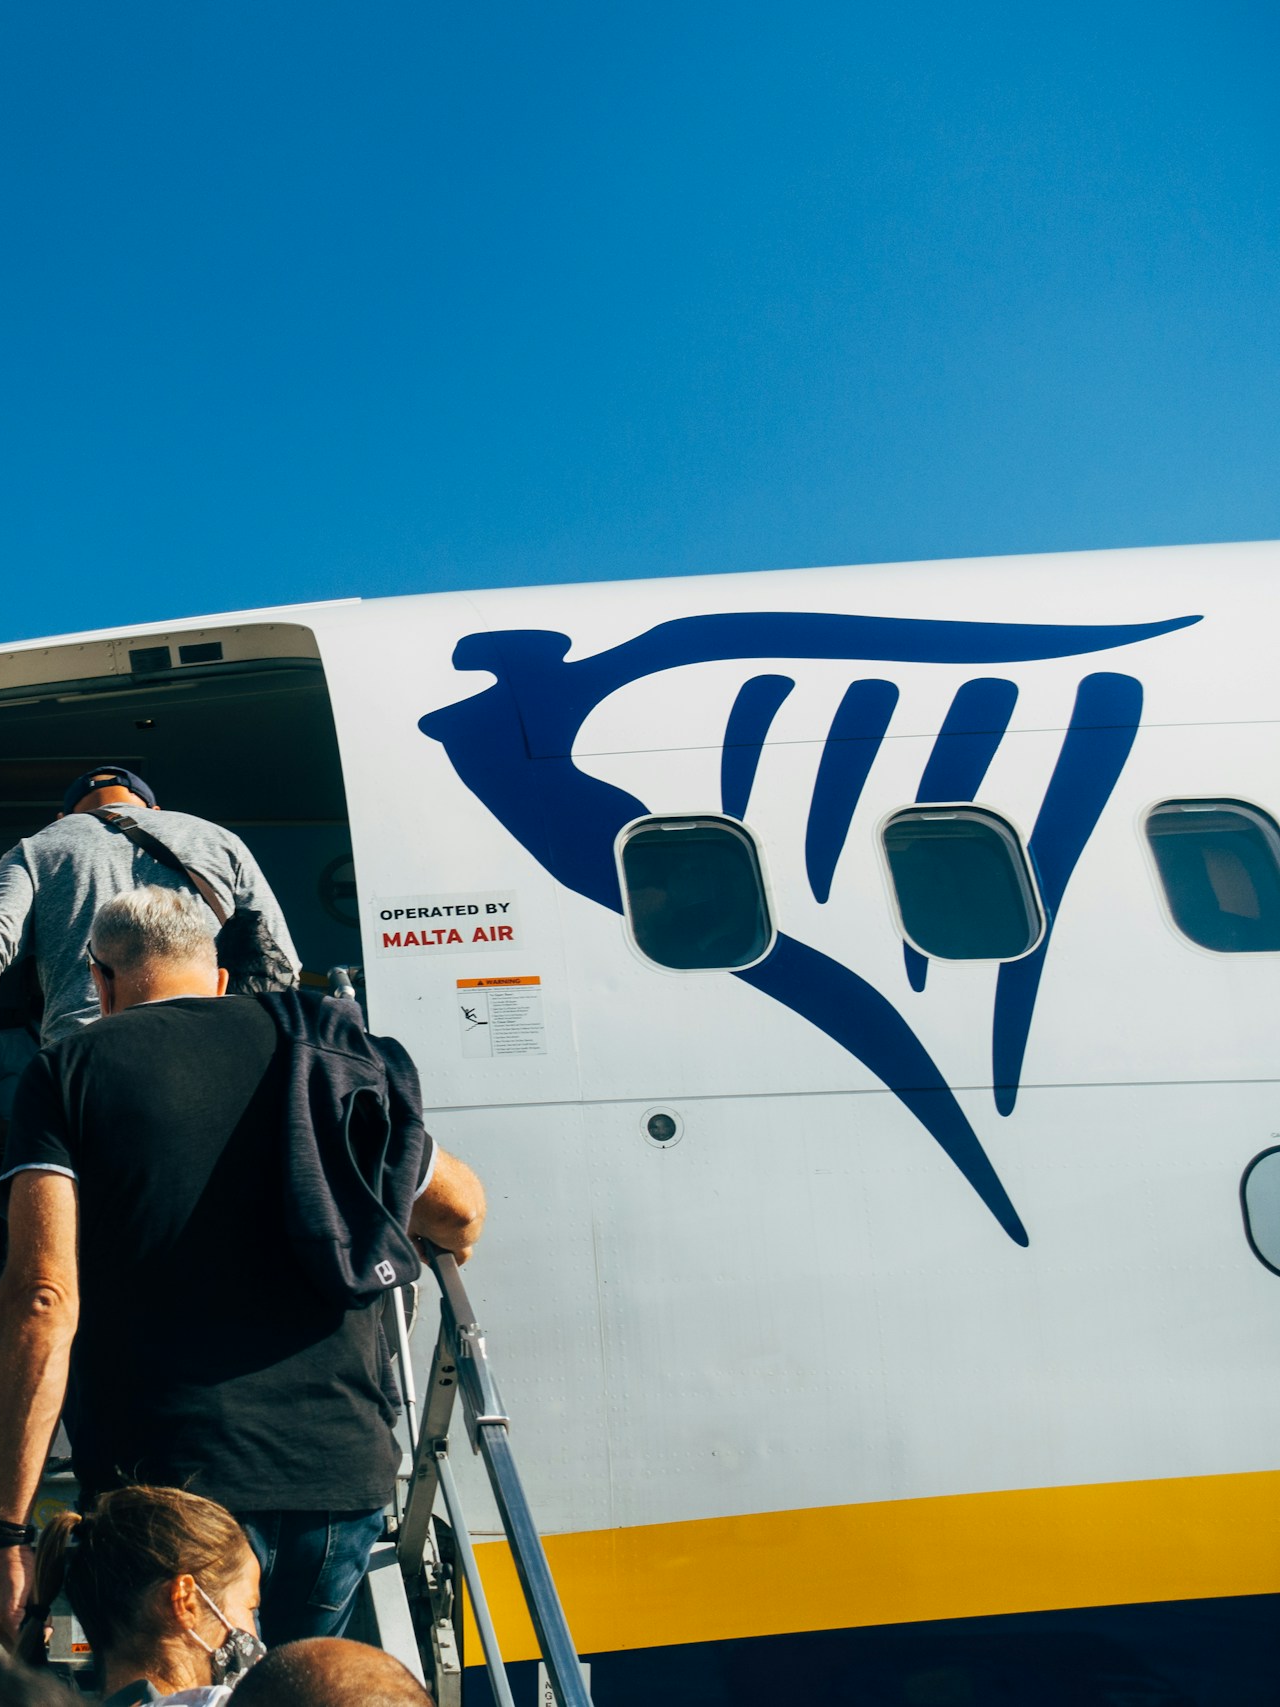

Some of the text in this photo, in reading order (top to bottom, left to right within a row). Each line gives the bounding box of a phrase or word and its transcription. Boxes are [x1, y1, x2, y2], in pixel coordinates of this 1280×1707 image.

[380, 902, 510, 920] OPERATED BY
[382, 925, 513, 948] MALTA AIR
[485, 978, 521, 986] WARNING
